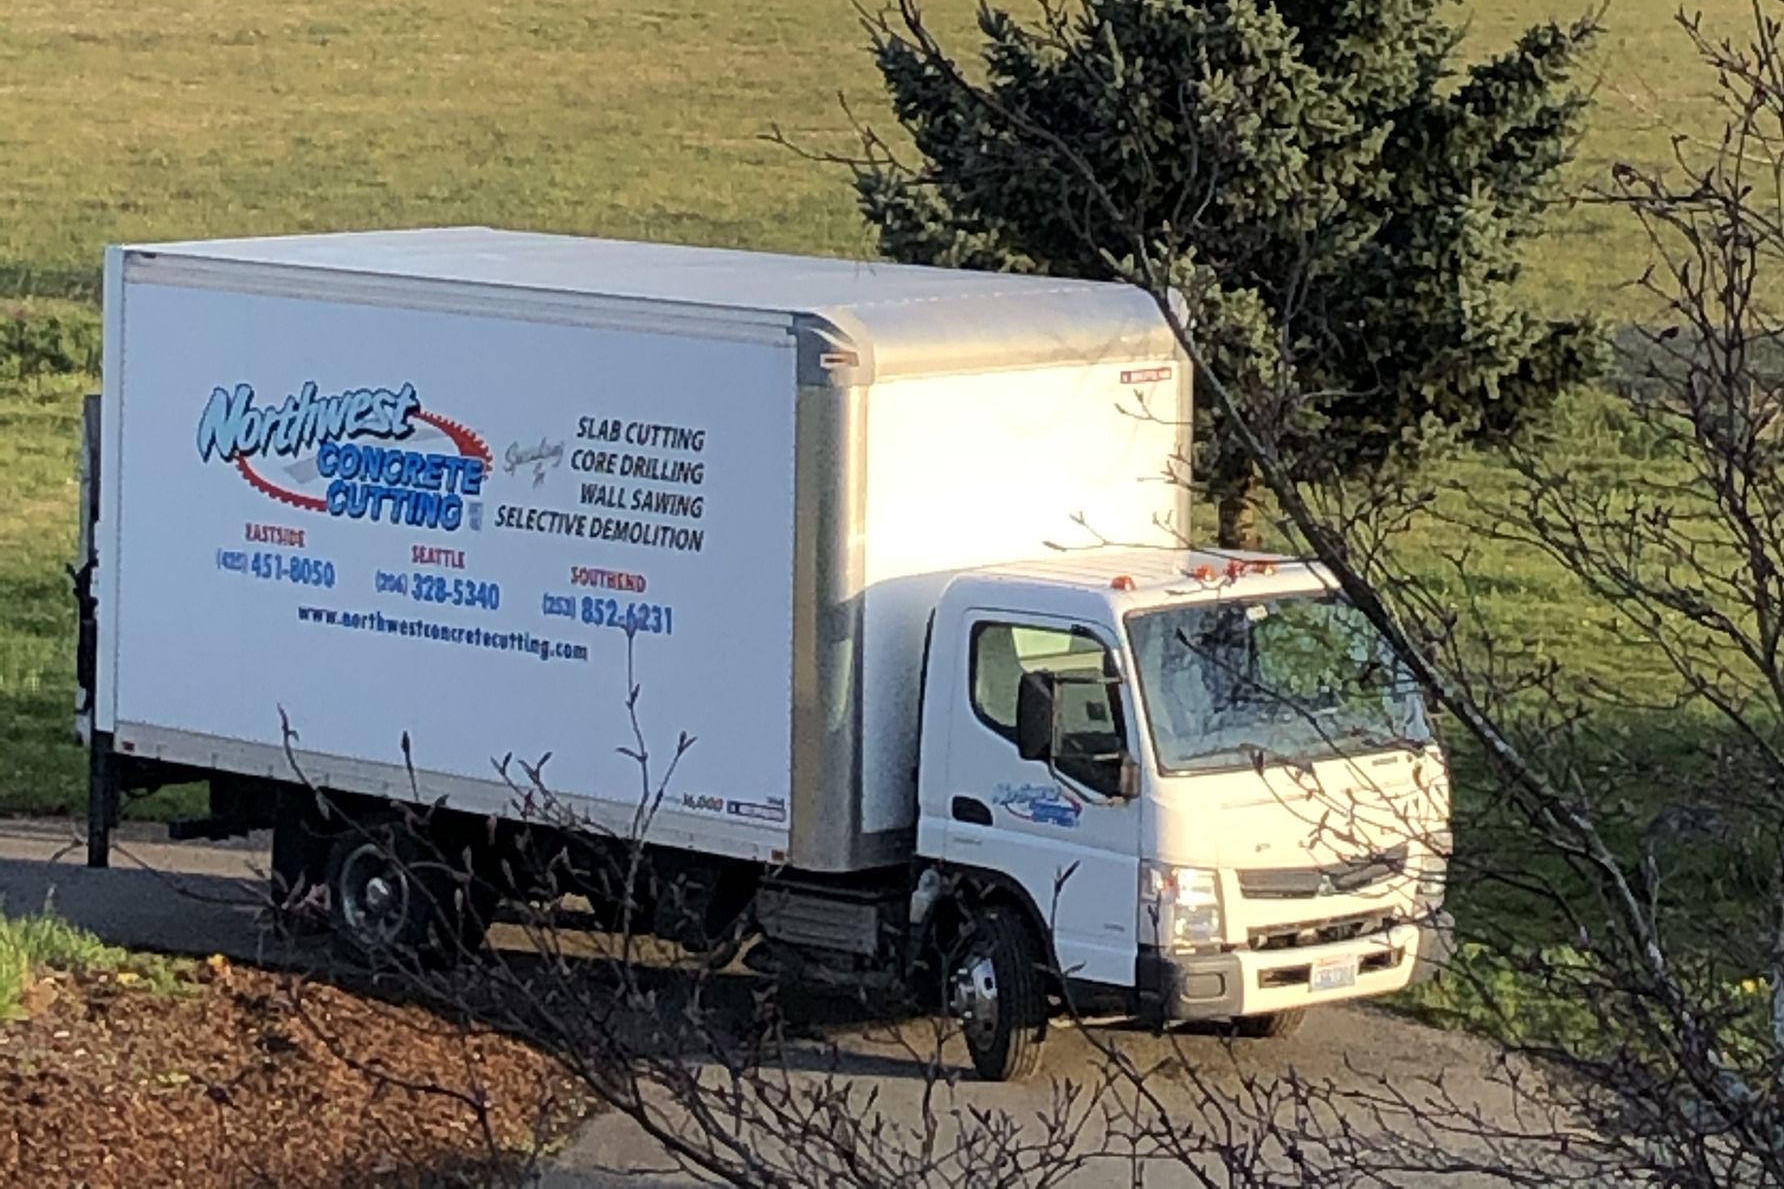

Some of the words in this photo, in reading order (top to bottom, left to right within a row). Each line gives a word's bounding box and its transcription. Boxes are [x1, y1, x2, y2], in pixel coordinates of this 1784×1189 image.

[197, 381, 420, 463] Northwest
[576, 416, 621, 442] SLAB
[625, 422, 706, 452] CUTTING
[317, 442, 484, 495] CONCRETE
[571, 449, 620, 475] CORE
[620, 454, 704, 485] DRILLING
[326, 479, 463, 531] CUTTING
[580, 482, 627, 509] WALL
[630, 488, 704, 519] SAWING
[244, 522, 306, 548] EASTSIDE
[495, 505, 588, 537] SELECTIVE
[589, 517, 705, 552] DEMOLITION
[251, 551, 336, 588] 451-8050
[411, 545, 466, 569] SEATTLE
[411, 572, 500, 610] 328-5340
[570, 566, 647, 593] SOUTHEND
[298, 606, 588, 660] www.northwestconcretecutting.com
